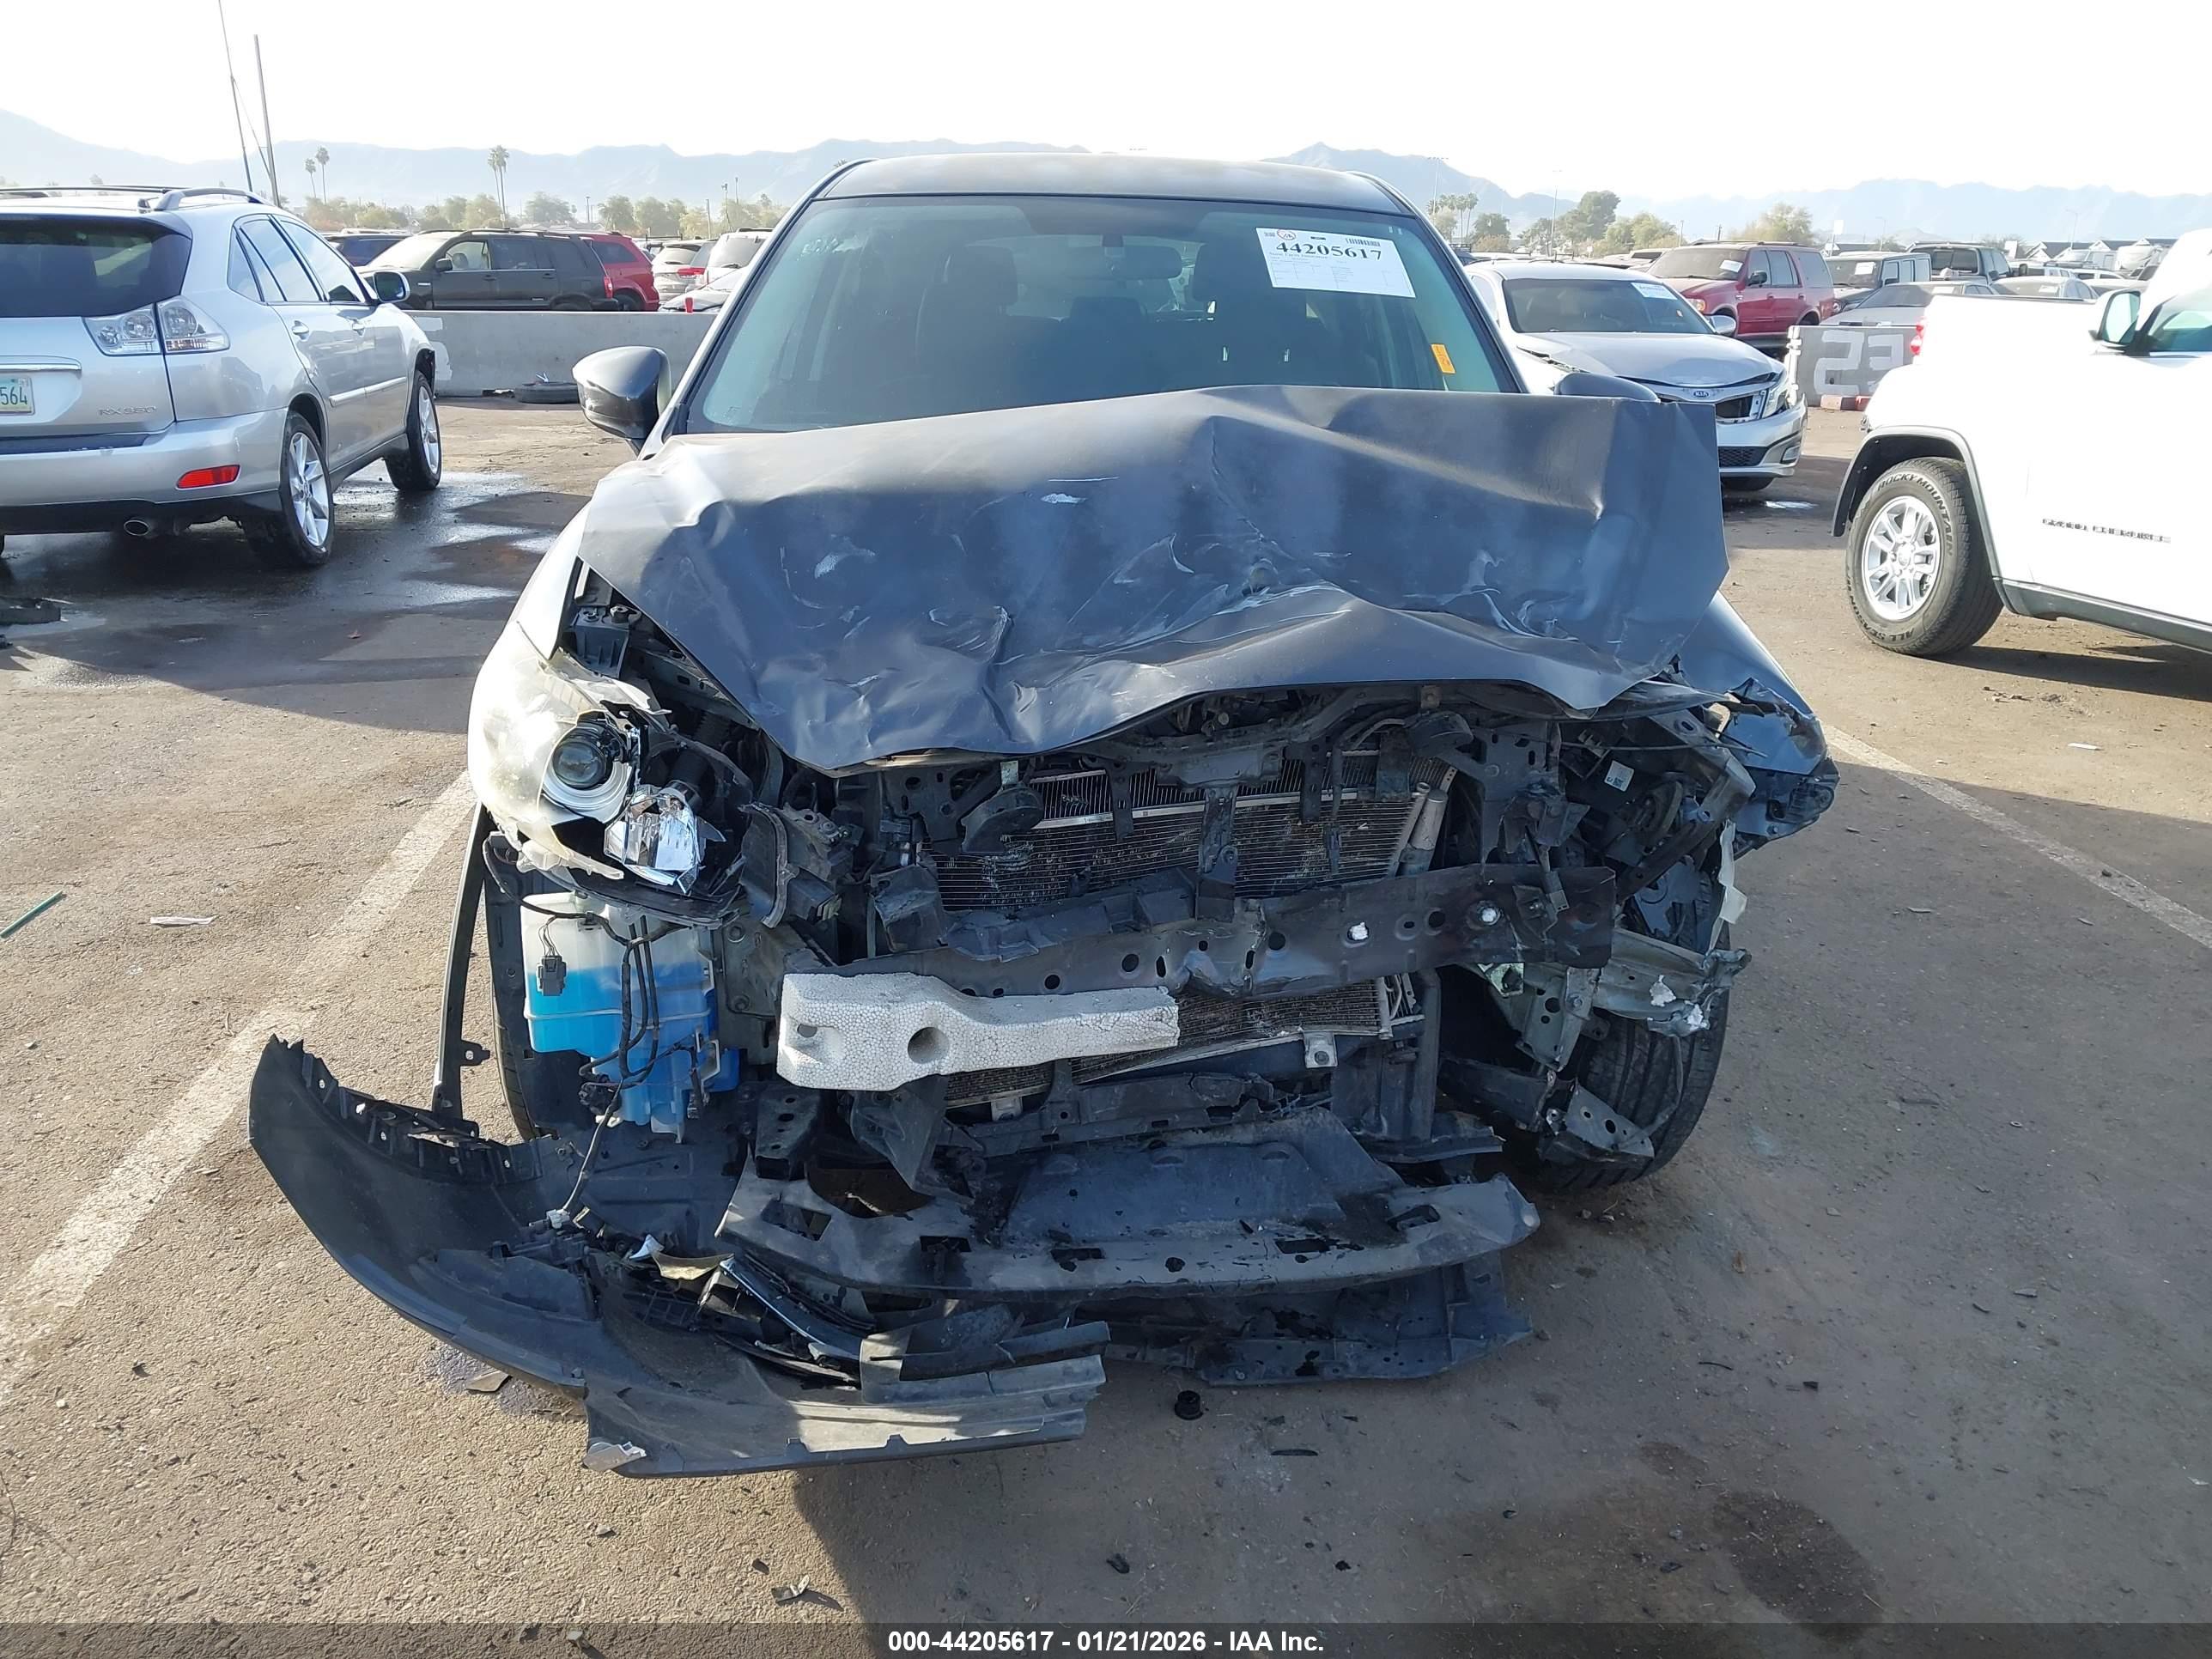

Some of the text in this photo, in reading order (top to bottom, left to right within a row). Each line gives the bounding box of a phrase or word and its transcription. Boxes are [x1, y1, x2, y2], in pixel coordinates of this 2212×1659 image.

[1276, 241, 1382, 260] 44205617
[0, 386, 27, 405] 564
[96, 407, 122, 416] RX
[1877, 472, 1954, 556] ROCKY MOUNTAIN
[1889, 627, 1915, 642] ALL
